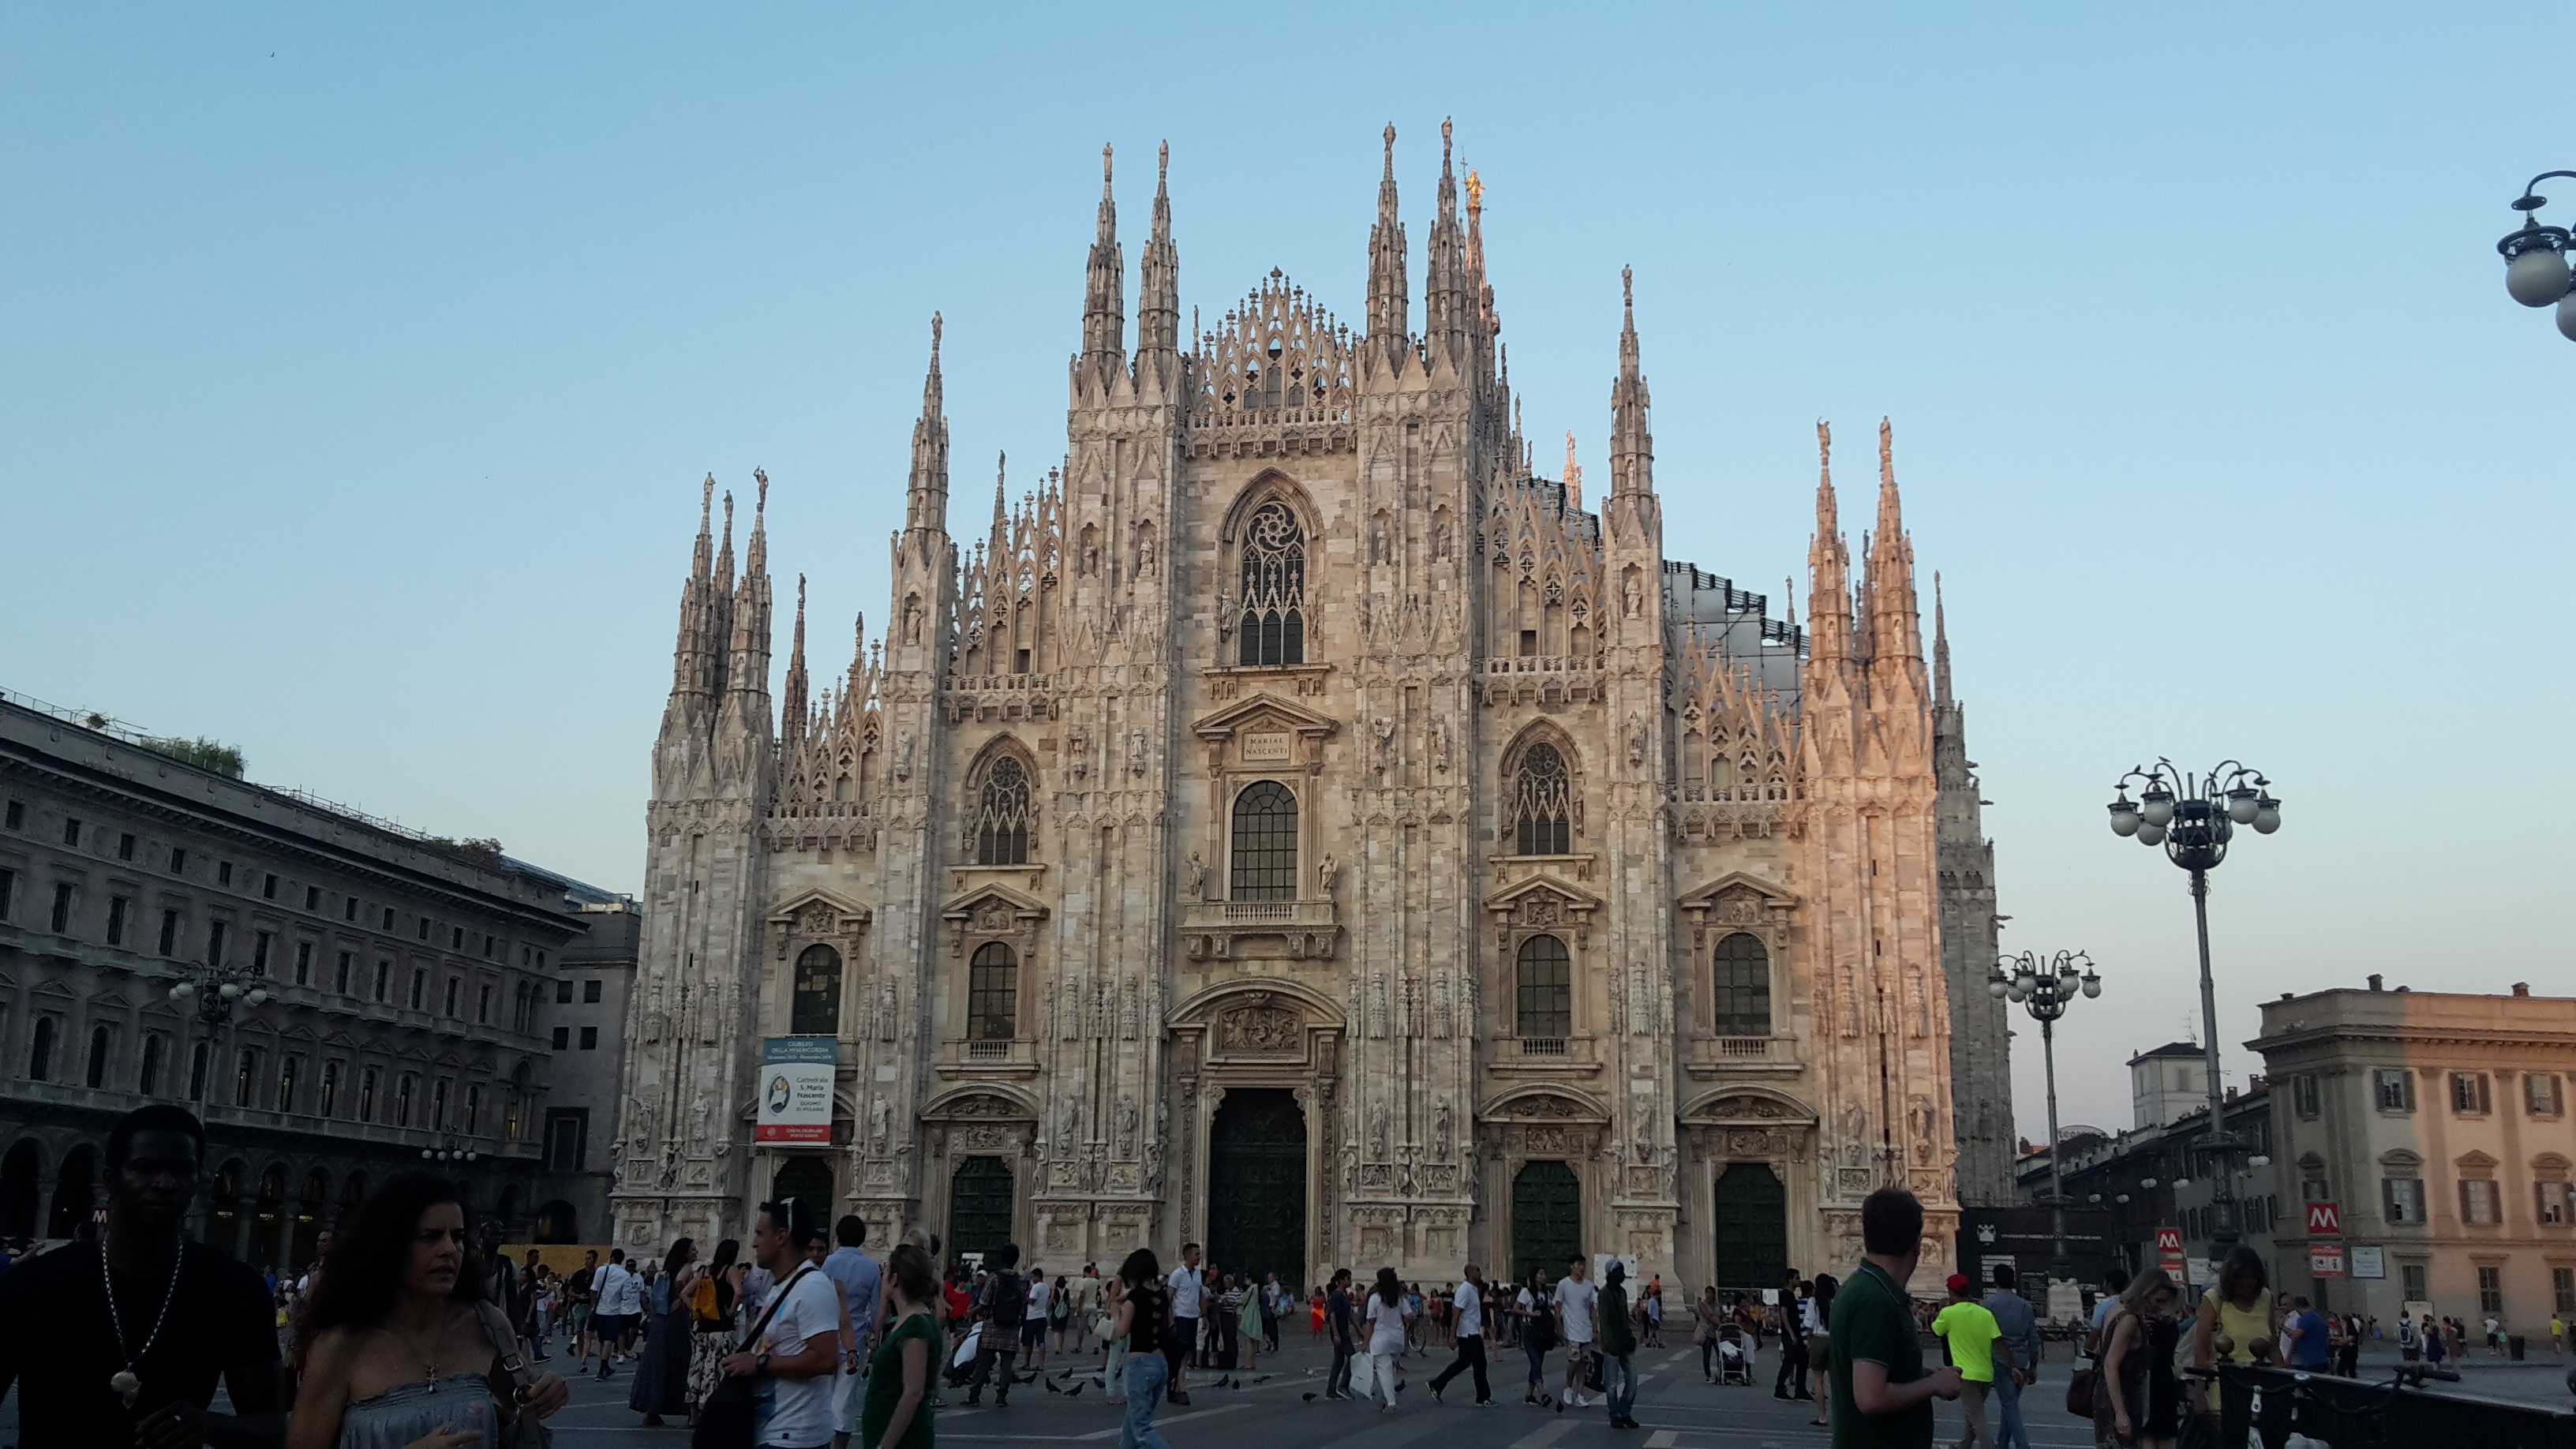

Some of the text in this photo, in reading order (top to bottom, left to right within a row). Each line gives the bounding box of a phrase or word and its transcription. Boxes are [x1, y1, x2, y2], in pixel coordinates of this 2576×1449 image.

[92, 1210, 107, 1223] M
[2309, 1207, 2338, 1228] M
[2159, 1233, 2179, 1248] M
